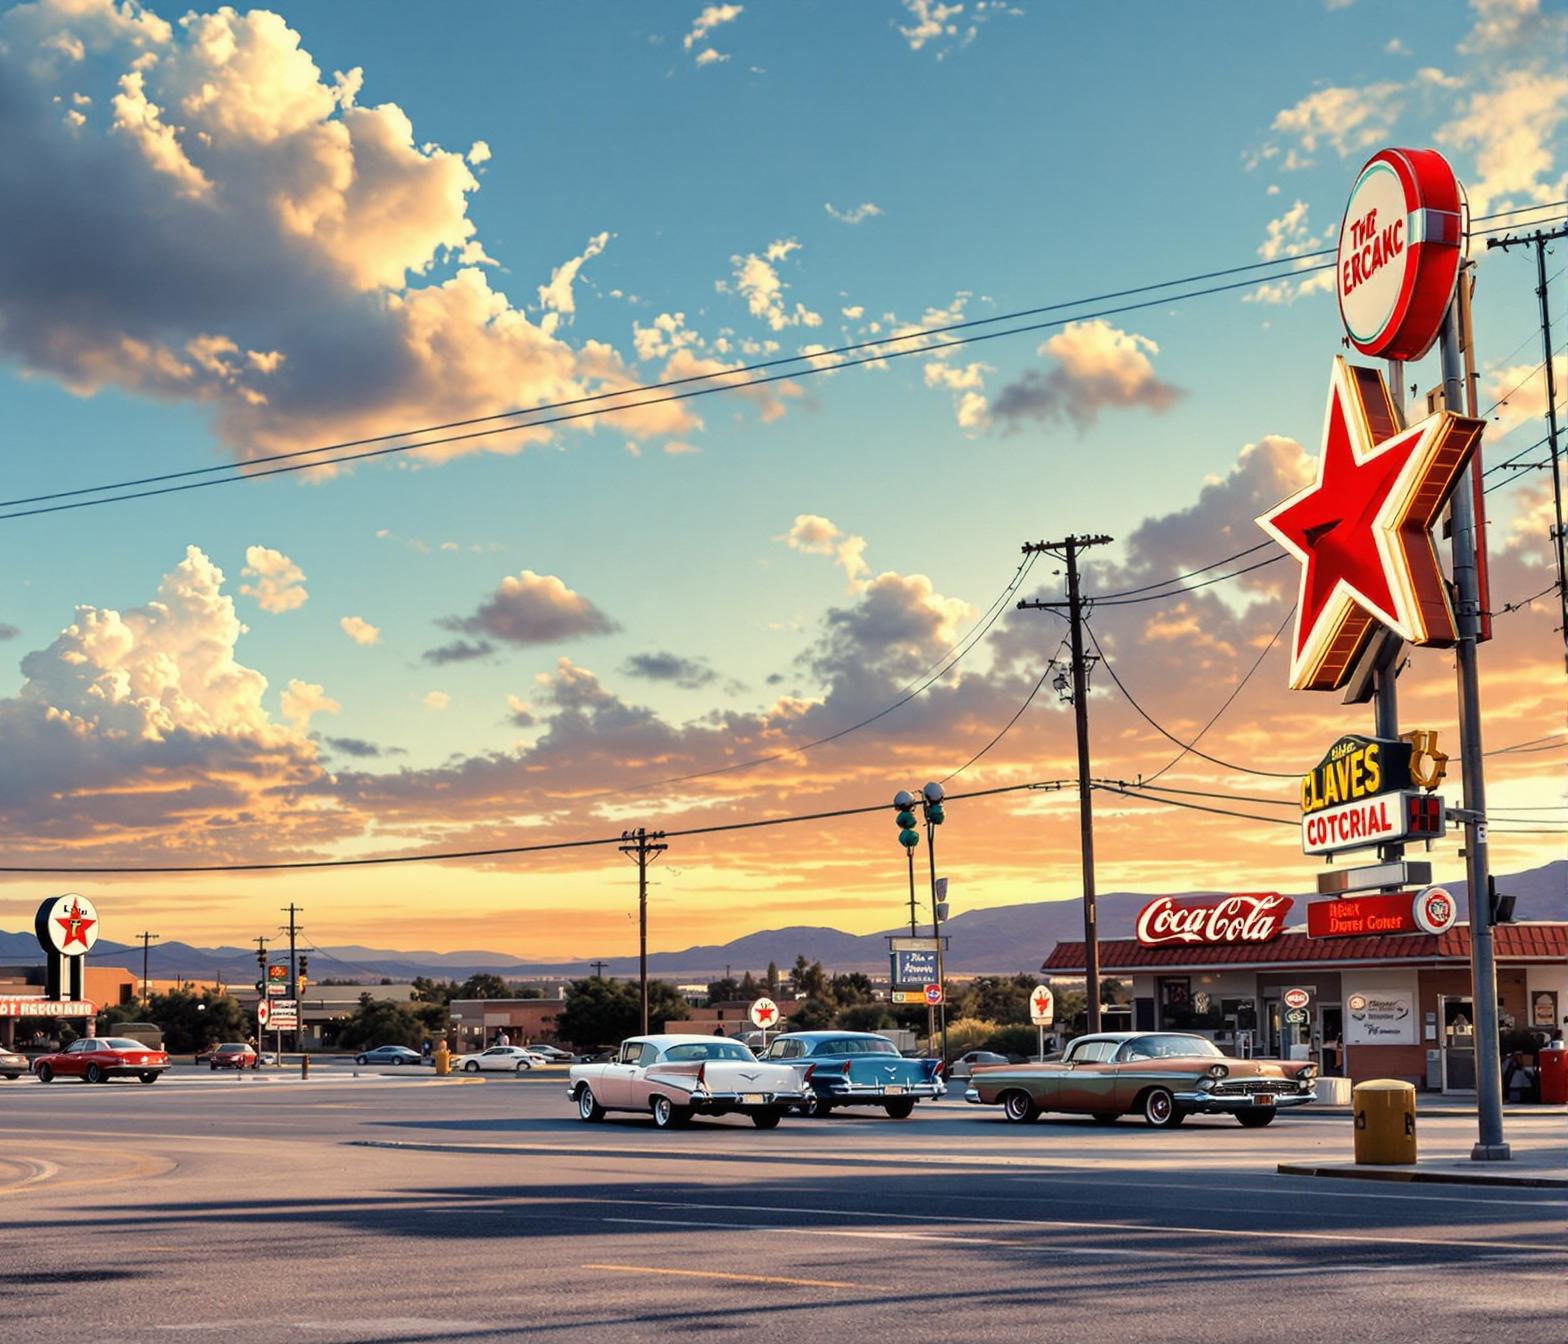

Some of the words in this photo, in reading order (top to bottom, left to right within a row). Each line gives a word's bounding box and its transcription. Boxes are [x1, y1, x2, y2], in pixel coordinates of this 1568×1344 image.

[1300, 743, 1380, 813] CLAVES
[1307, 802, 1392, 846] COTCRIAL
[1138, 896, 1284, 943] Coca-Cola
